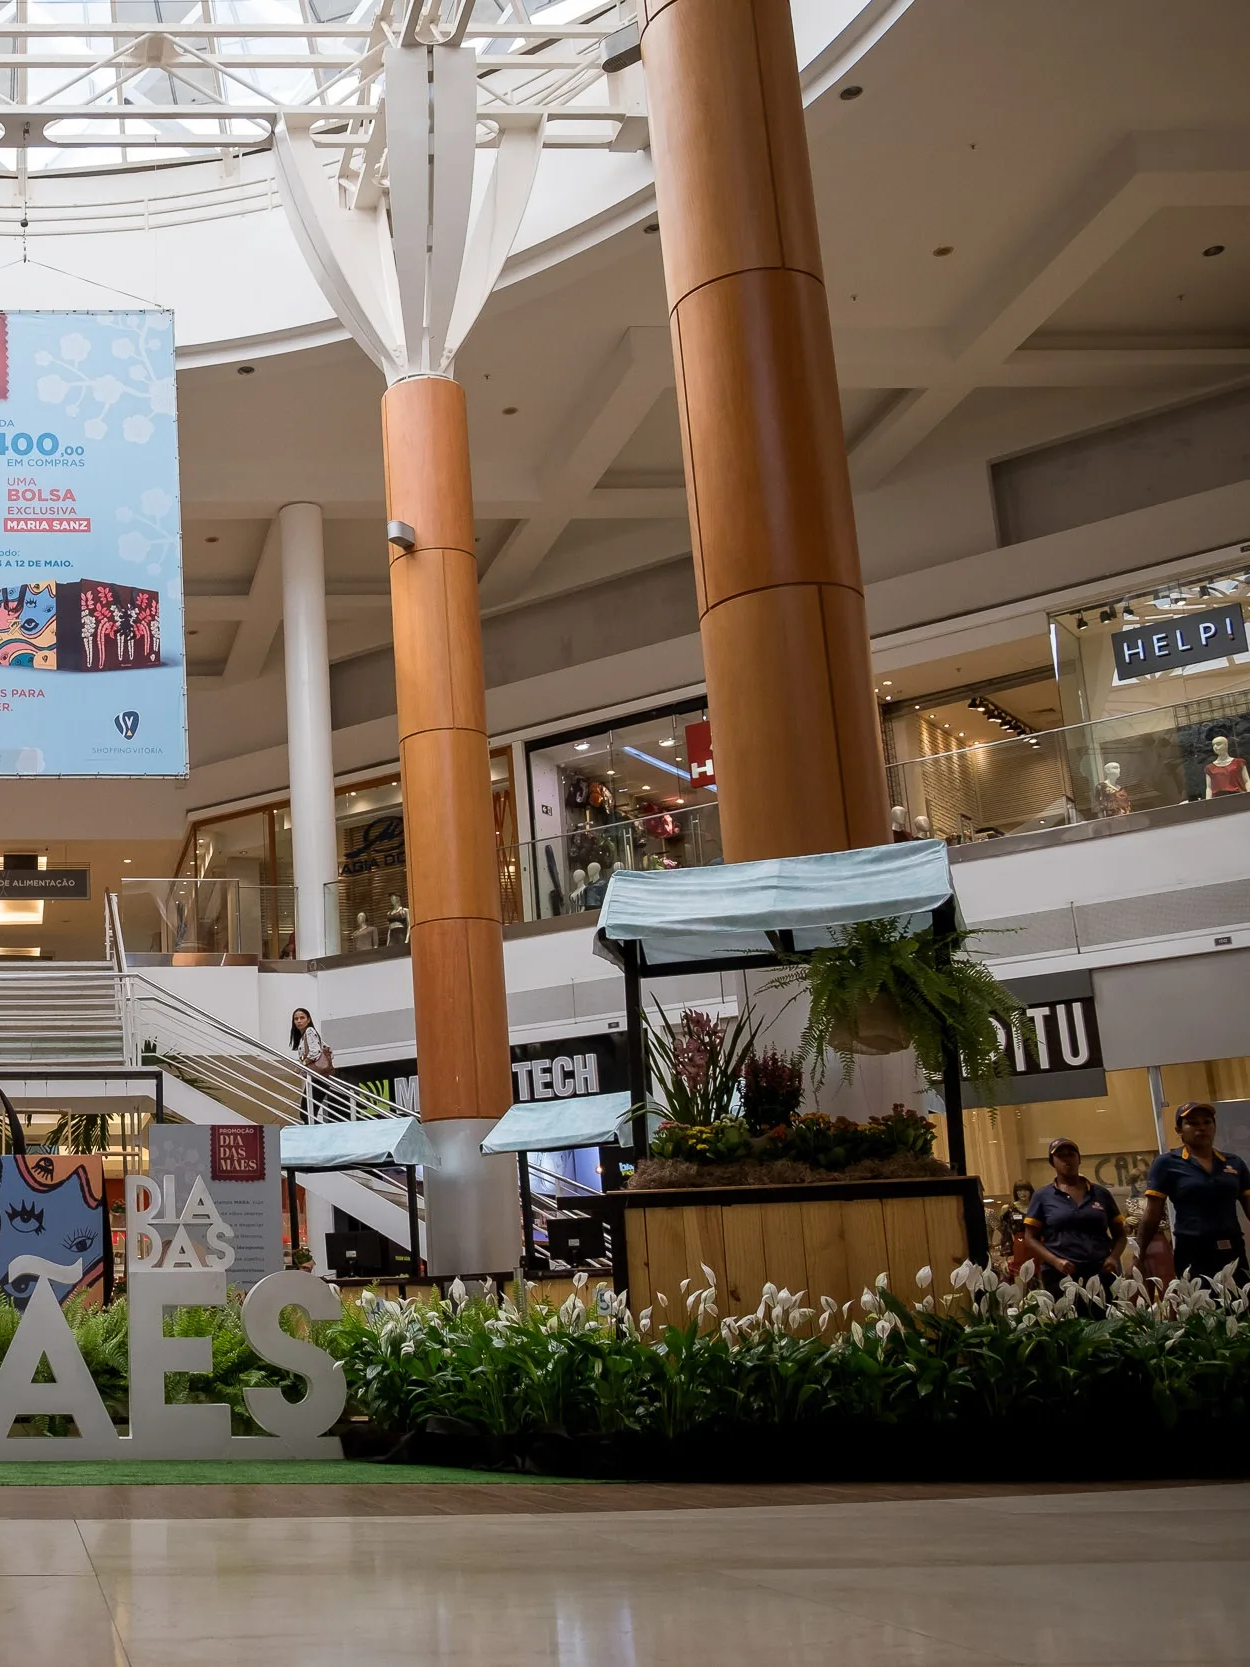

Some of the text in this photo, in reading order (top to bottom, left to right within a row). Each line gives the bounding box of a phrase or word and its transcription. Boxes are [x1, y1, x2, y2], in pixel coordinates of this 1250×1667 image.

[7, 458, 85, 467] EM COMPRAS
[7, 477, 37, 487] UMA
[7, 488, 77, 502] BOLSA
[7, 506, 77, 516] EXCLUSIVA
[7, 520, 88, 530] MARIA SANZ
[5, 559, 13, 568] A
[15, 559, 25, 568] 12
[27, 559, 41, 568] DE
[44, 559, 73, 568] MAIO.
[1123, 617, 1235, 663] HELP!
[10, 688, 45, 698] PARA
[13, 878, 75, 887] ALIMENTAÇÃO
[512, 1053, 599, 1101] TECH
[219, 1127, 255, 1135] PROMOÇÃO
[219, 1135, 244, 1146] DIA
[219, 1147, 246, 1158] DAS
[219, 1157, 257, 1171] MÃES
[125, 1174, 223, 1222] DIA
[126, 1222, 236, 1272] DAS
